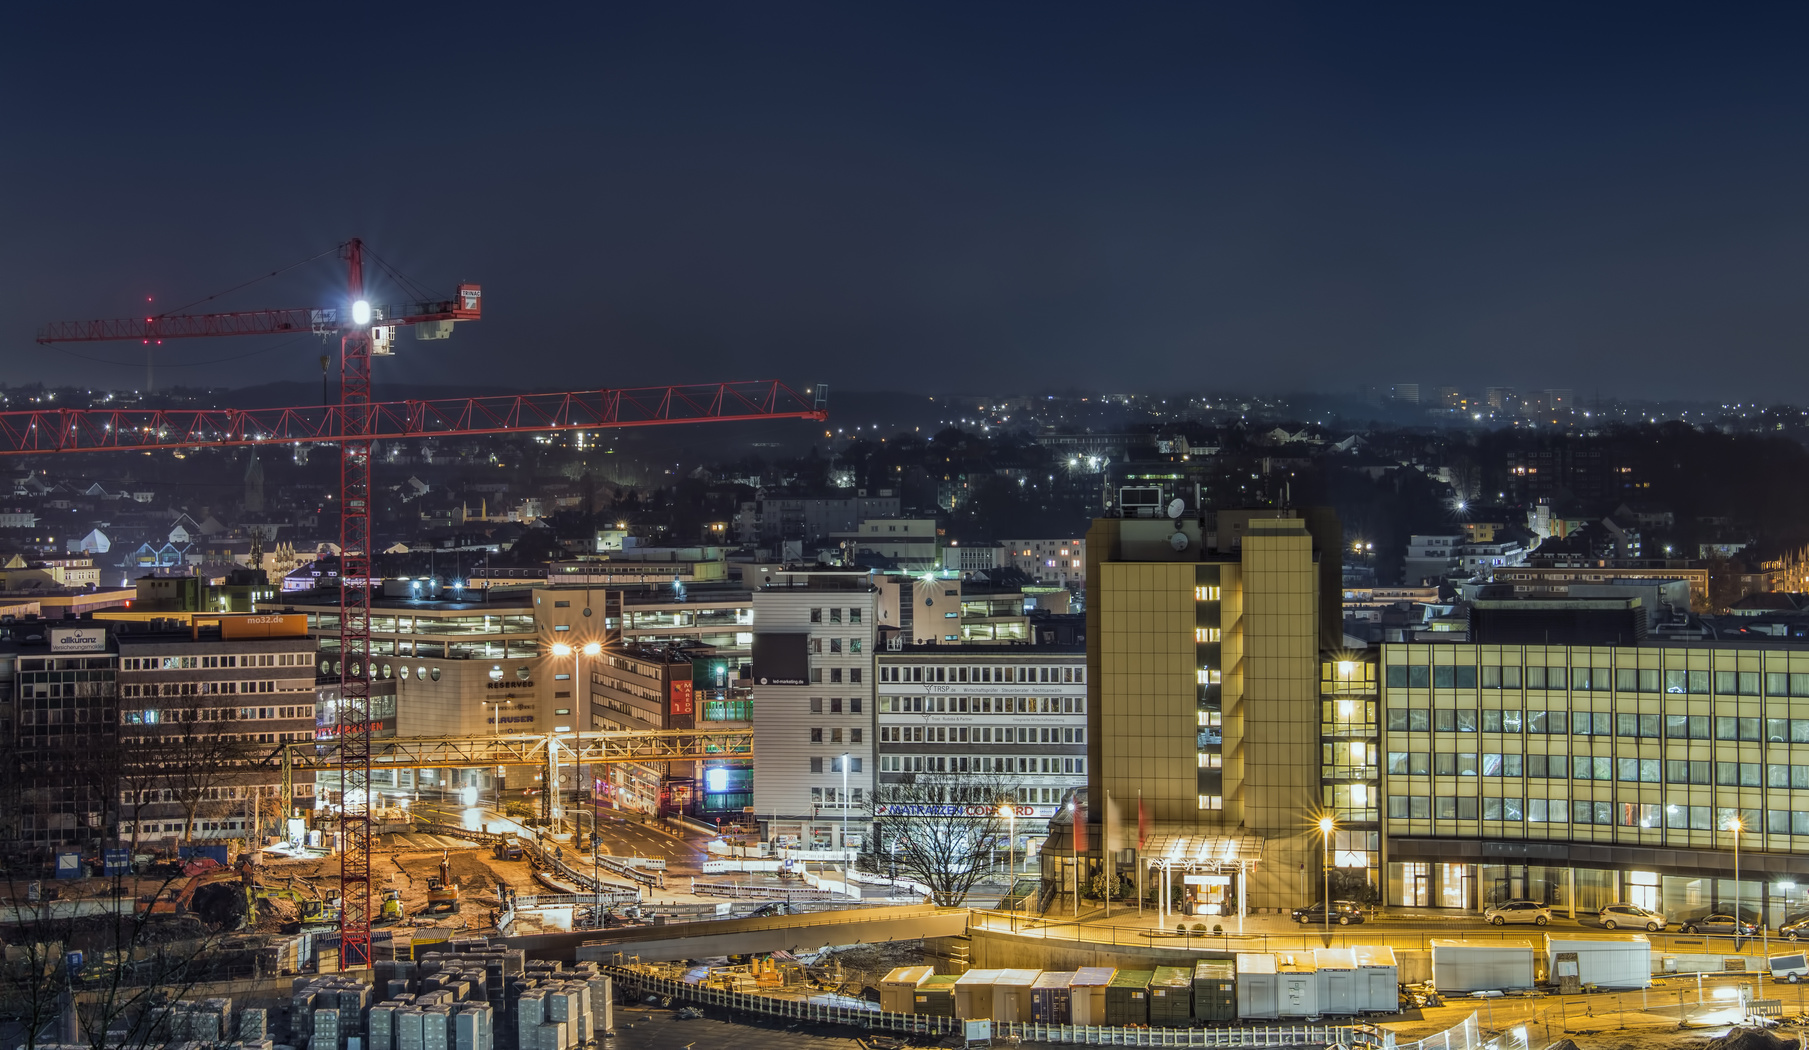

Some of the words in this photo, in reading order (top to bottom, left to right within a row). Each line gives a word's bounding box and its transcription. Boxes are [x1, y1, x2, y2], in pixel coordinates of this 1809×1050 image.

[247, 616, 284, 624] mo32.de
[60, 636, 97, 644] allkuranz
[487, 681, 534, 689] RESERVED
[966, 805, 1034, 816] CONRD
